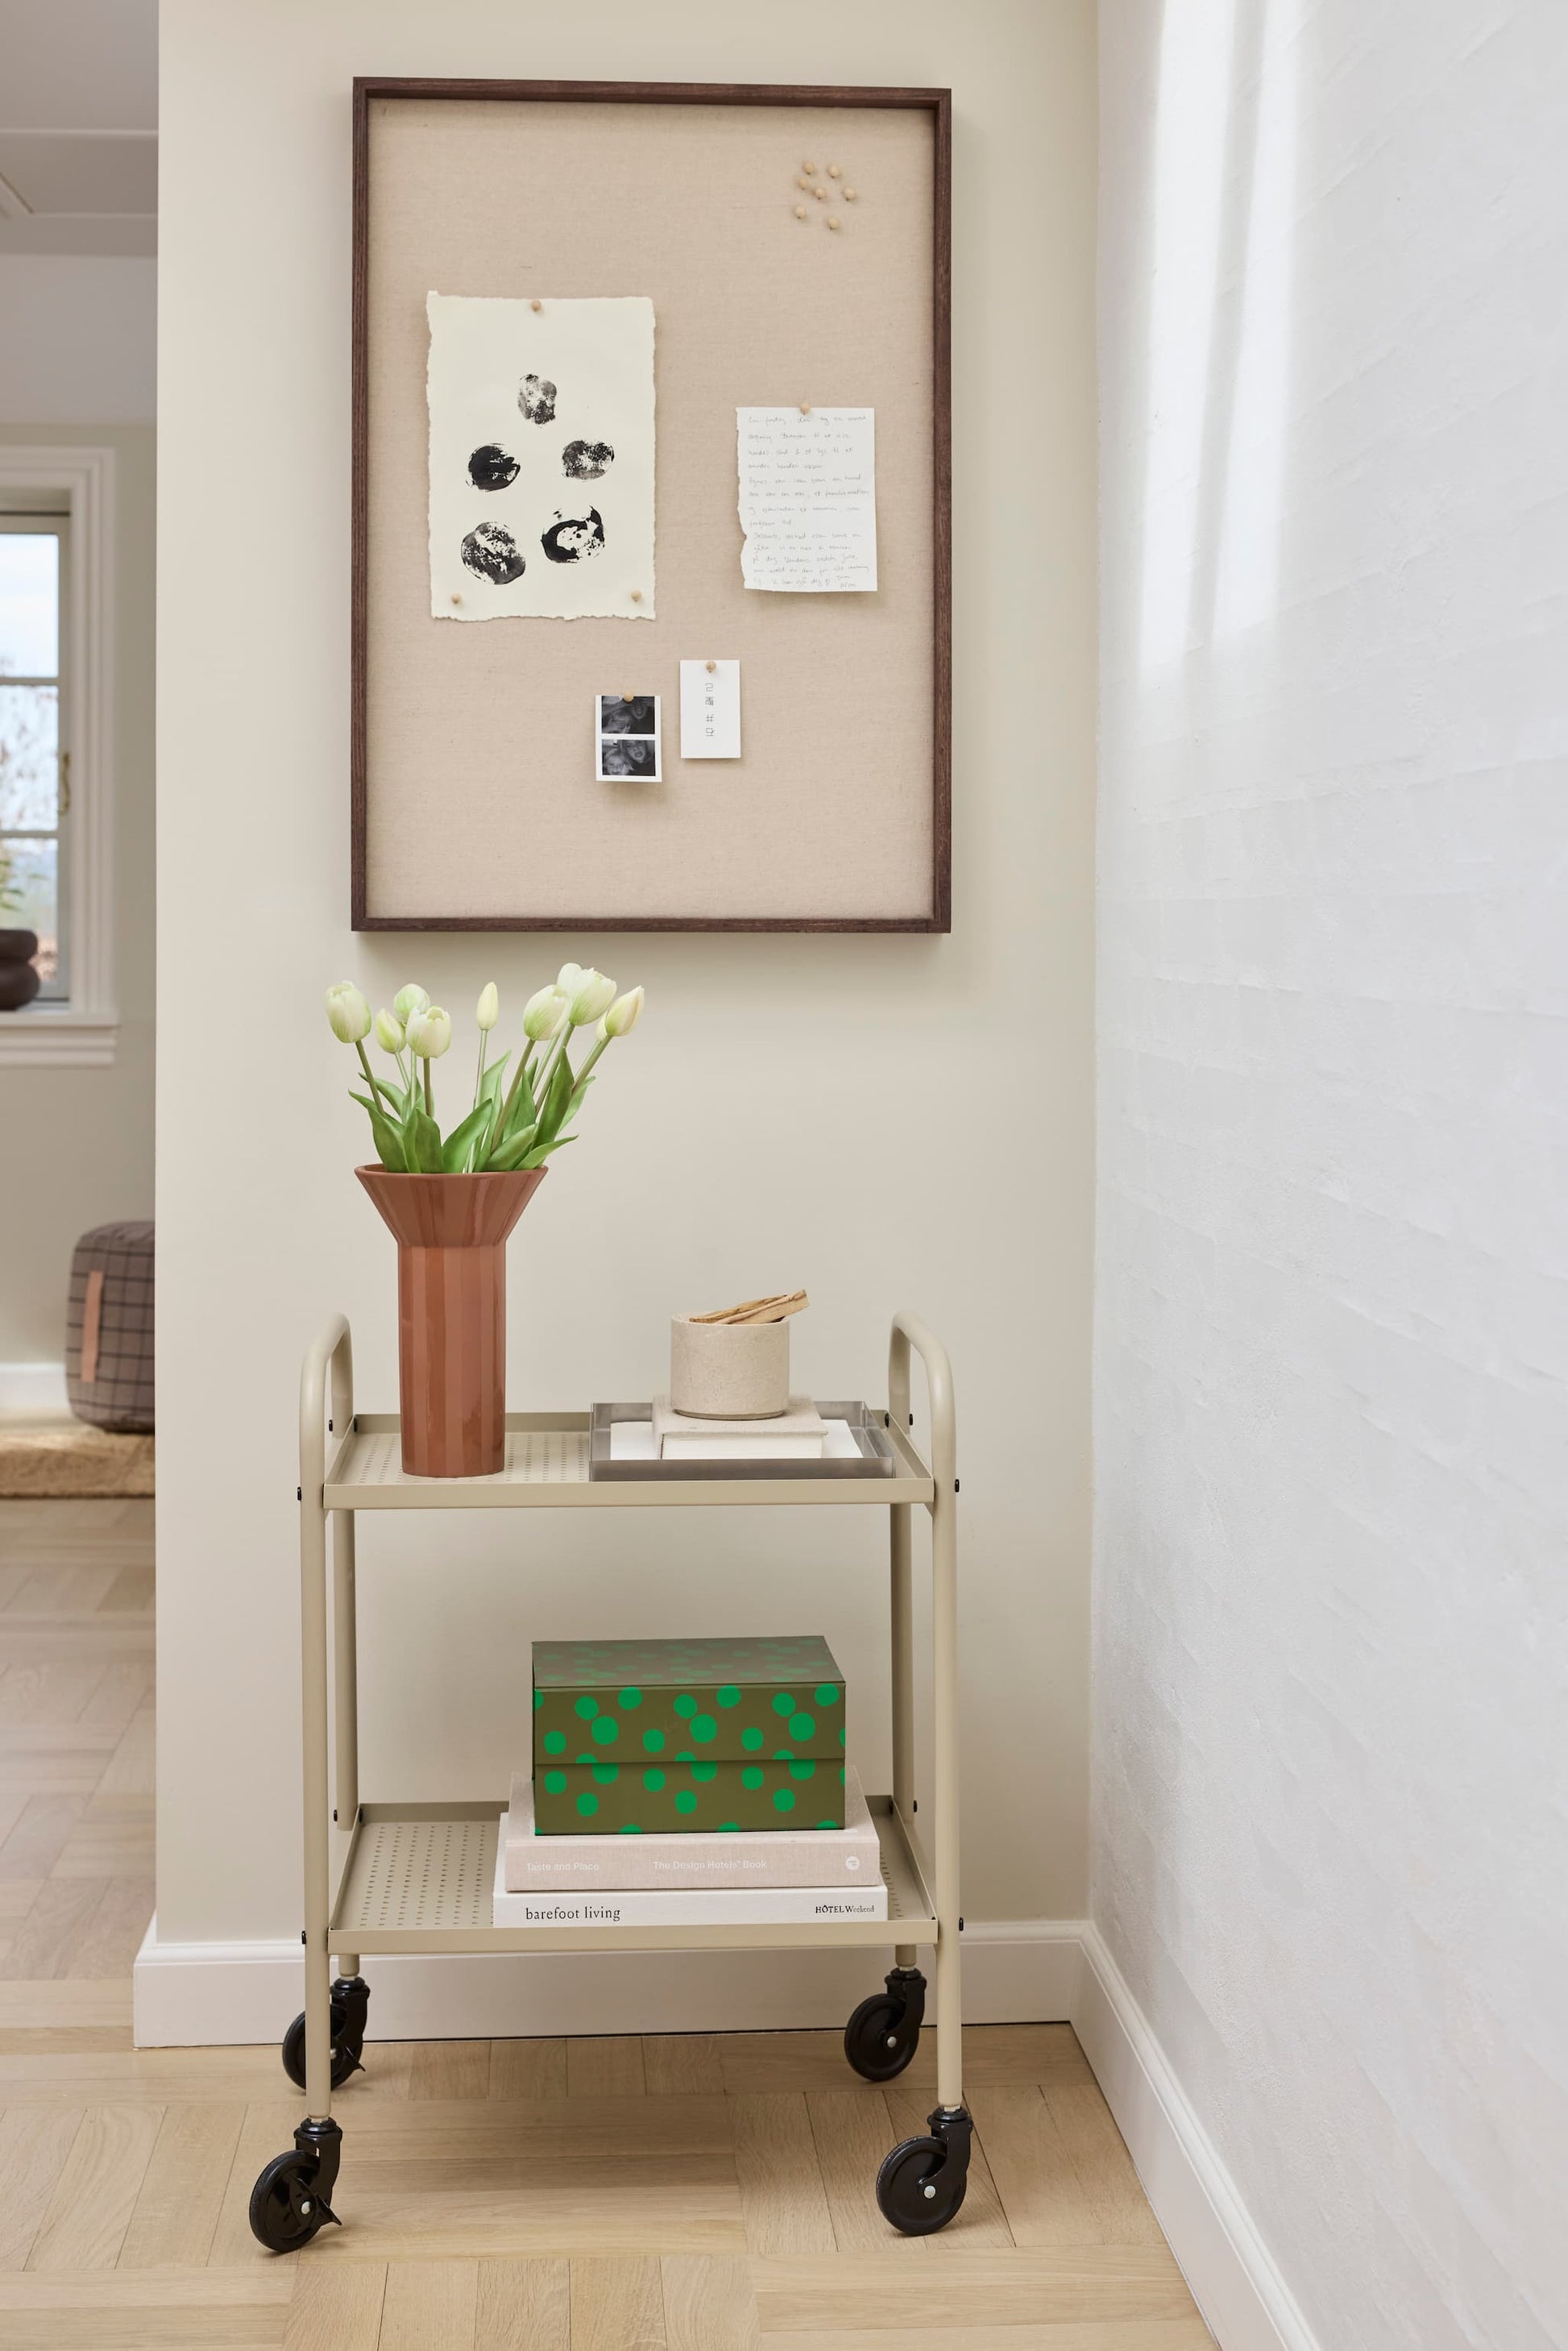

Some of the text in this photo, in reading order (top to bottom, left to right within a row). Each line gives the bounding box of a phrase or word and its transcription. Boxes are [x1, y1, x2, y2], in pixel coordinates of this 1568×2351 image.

[526, 1862, 600, 1871] Taste and Place
[653, 1861, 670, 1869] The
[673, 1861, 705, 1871] Design
[742, 1860, 767, 1869] Book
[525, 1906, 621, 1921] barefoot living
